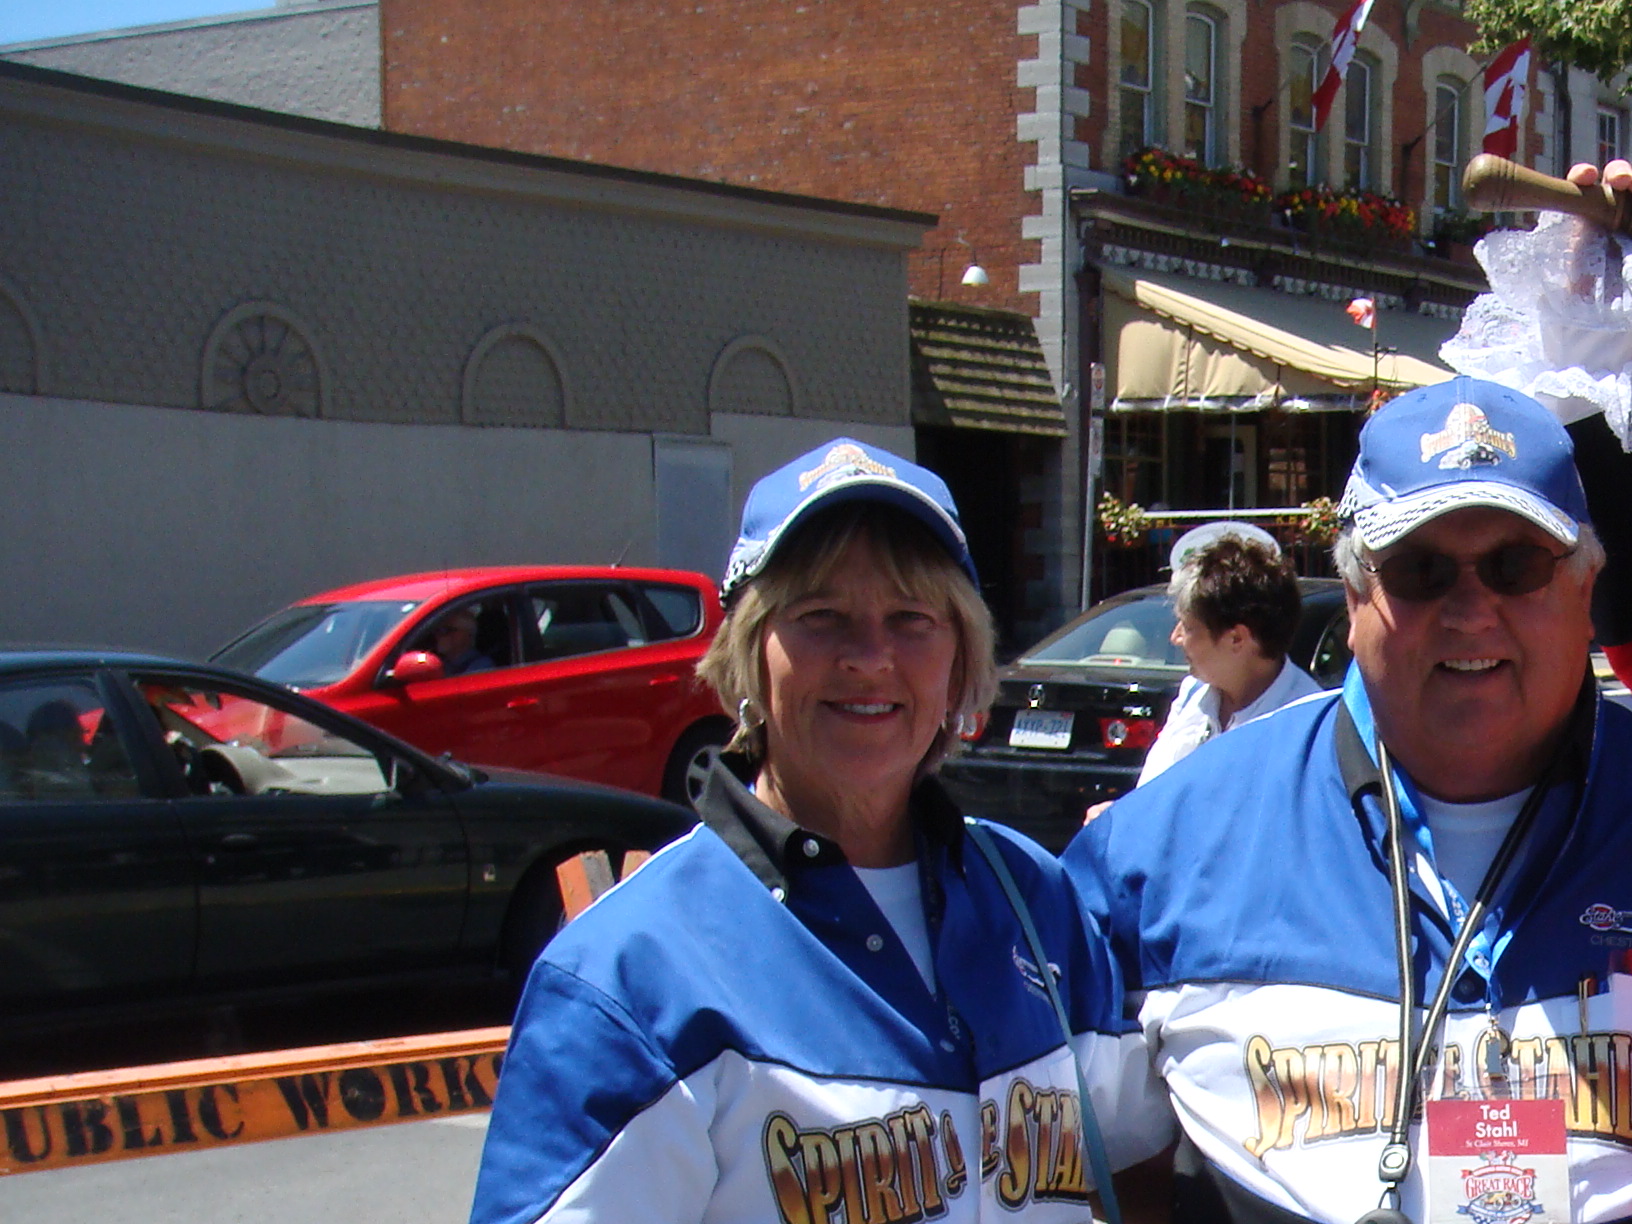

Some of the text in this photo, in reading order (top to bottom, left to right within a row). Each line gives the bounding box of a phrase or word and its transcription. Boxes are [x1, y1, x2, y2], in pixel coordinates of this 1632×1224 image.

[276, 1052, 505, 1131] WORK
[1243, 1035, 1400, 1159] SPIRIT
[1480, 1104, 1510, 1120] Ted
[1475, 1121, 1518, 1138] Stahl
[1465, 1177, 1532, 1199] GREAT RACE
